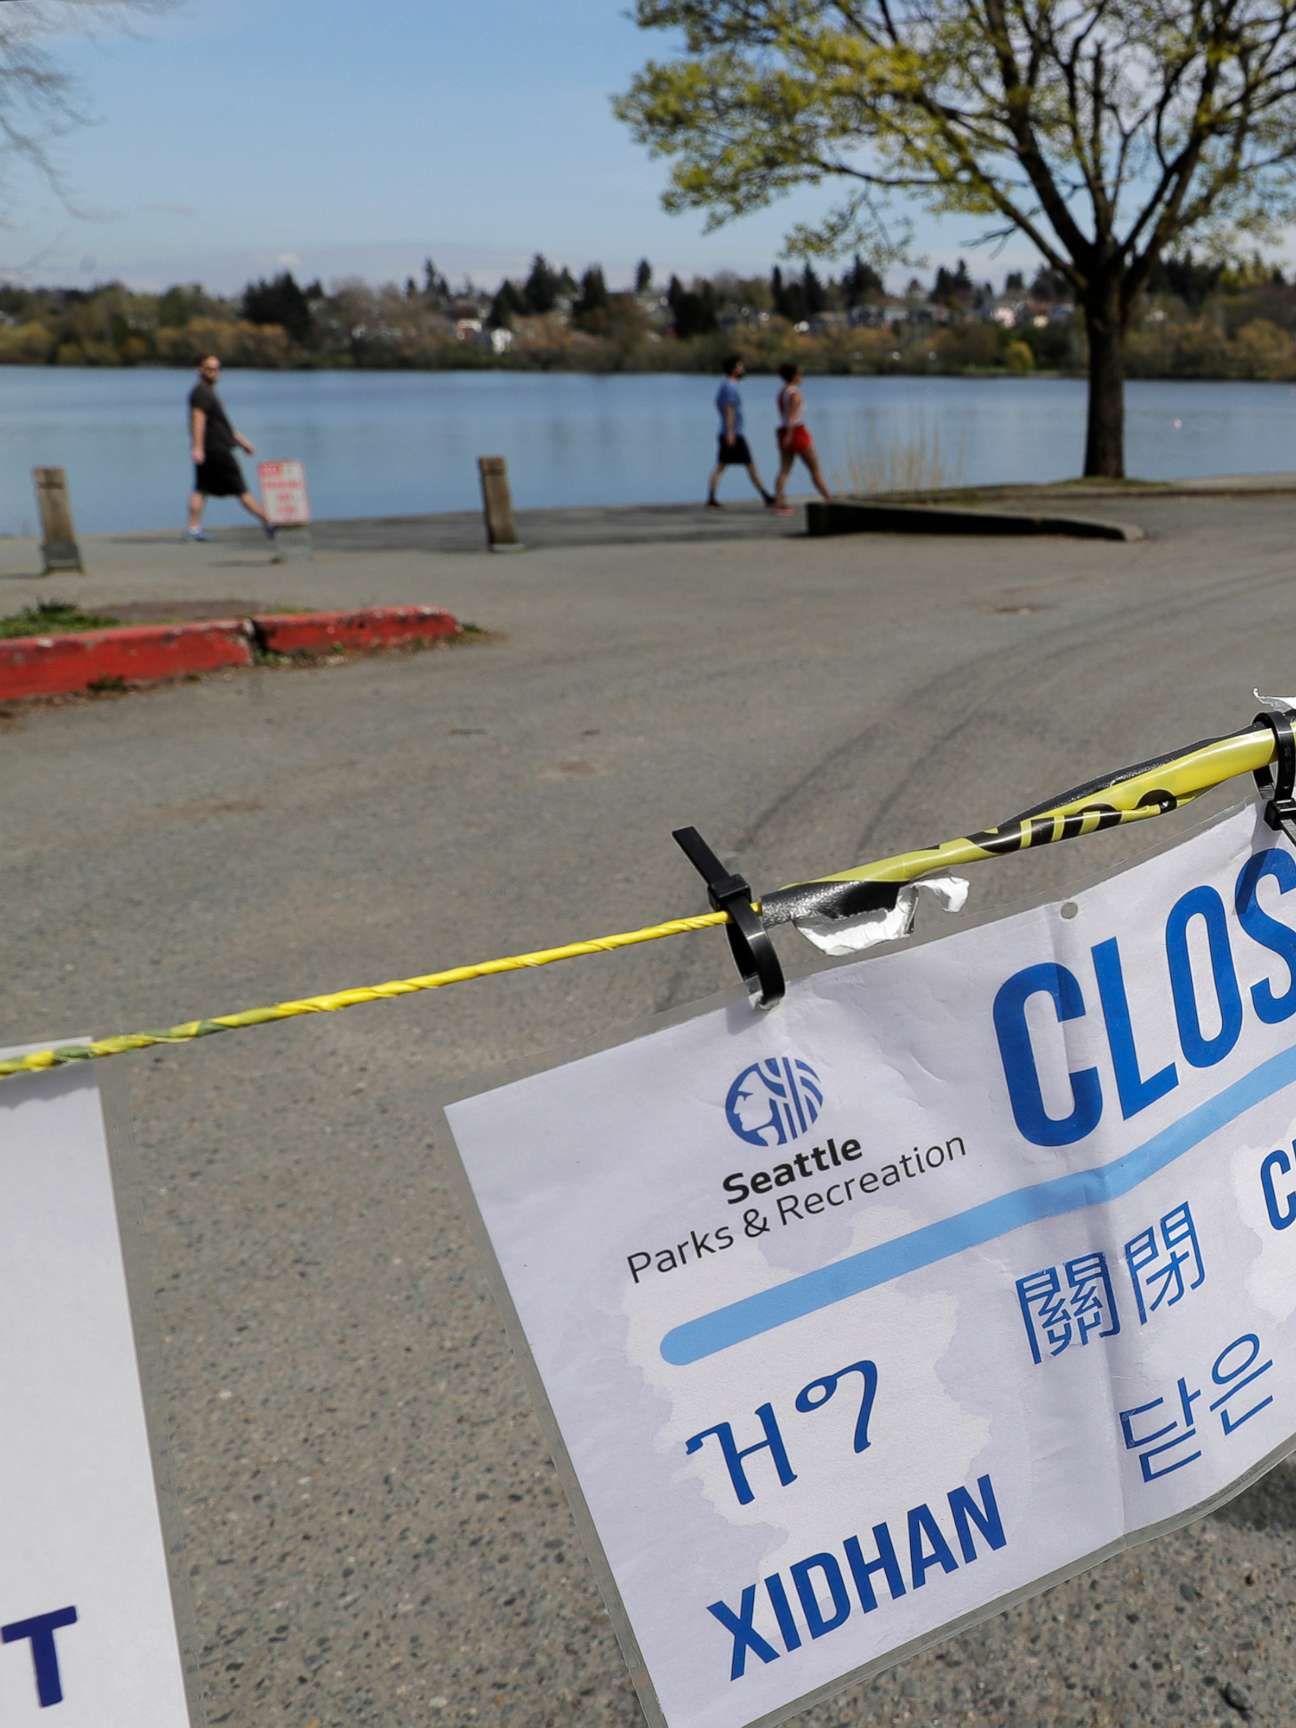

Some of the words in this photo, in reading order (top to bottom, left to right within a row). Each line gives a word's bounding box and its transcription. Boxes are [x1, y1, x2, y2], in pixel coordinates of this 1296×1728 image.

[626, 1225, 735, 1284] Parks
[742, 1208, 771, 1238] &
[776, 1135, 967, 1226] Recreation
[721, 1137, 864, 1205] Seattle
[1015, 1200, 1206, 1365] 關閉
[1119, 1332, 1274, 1484] 닫은
[705, 1472, 1008, 1682] XIDHAN
